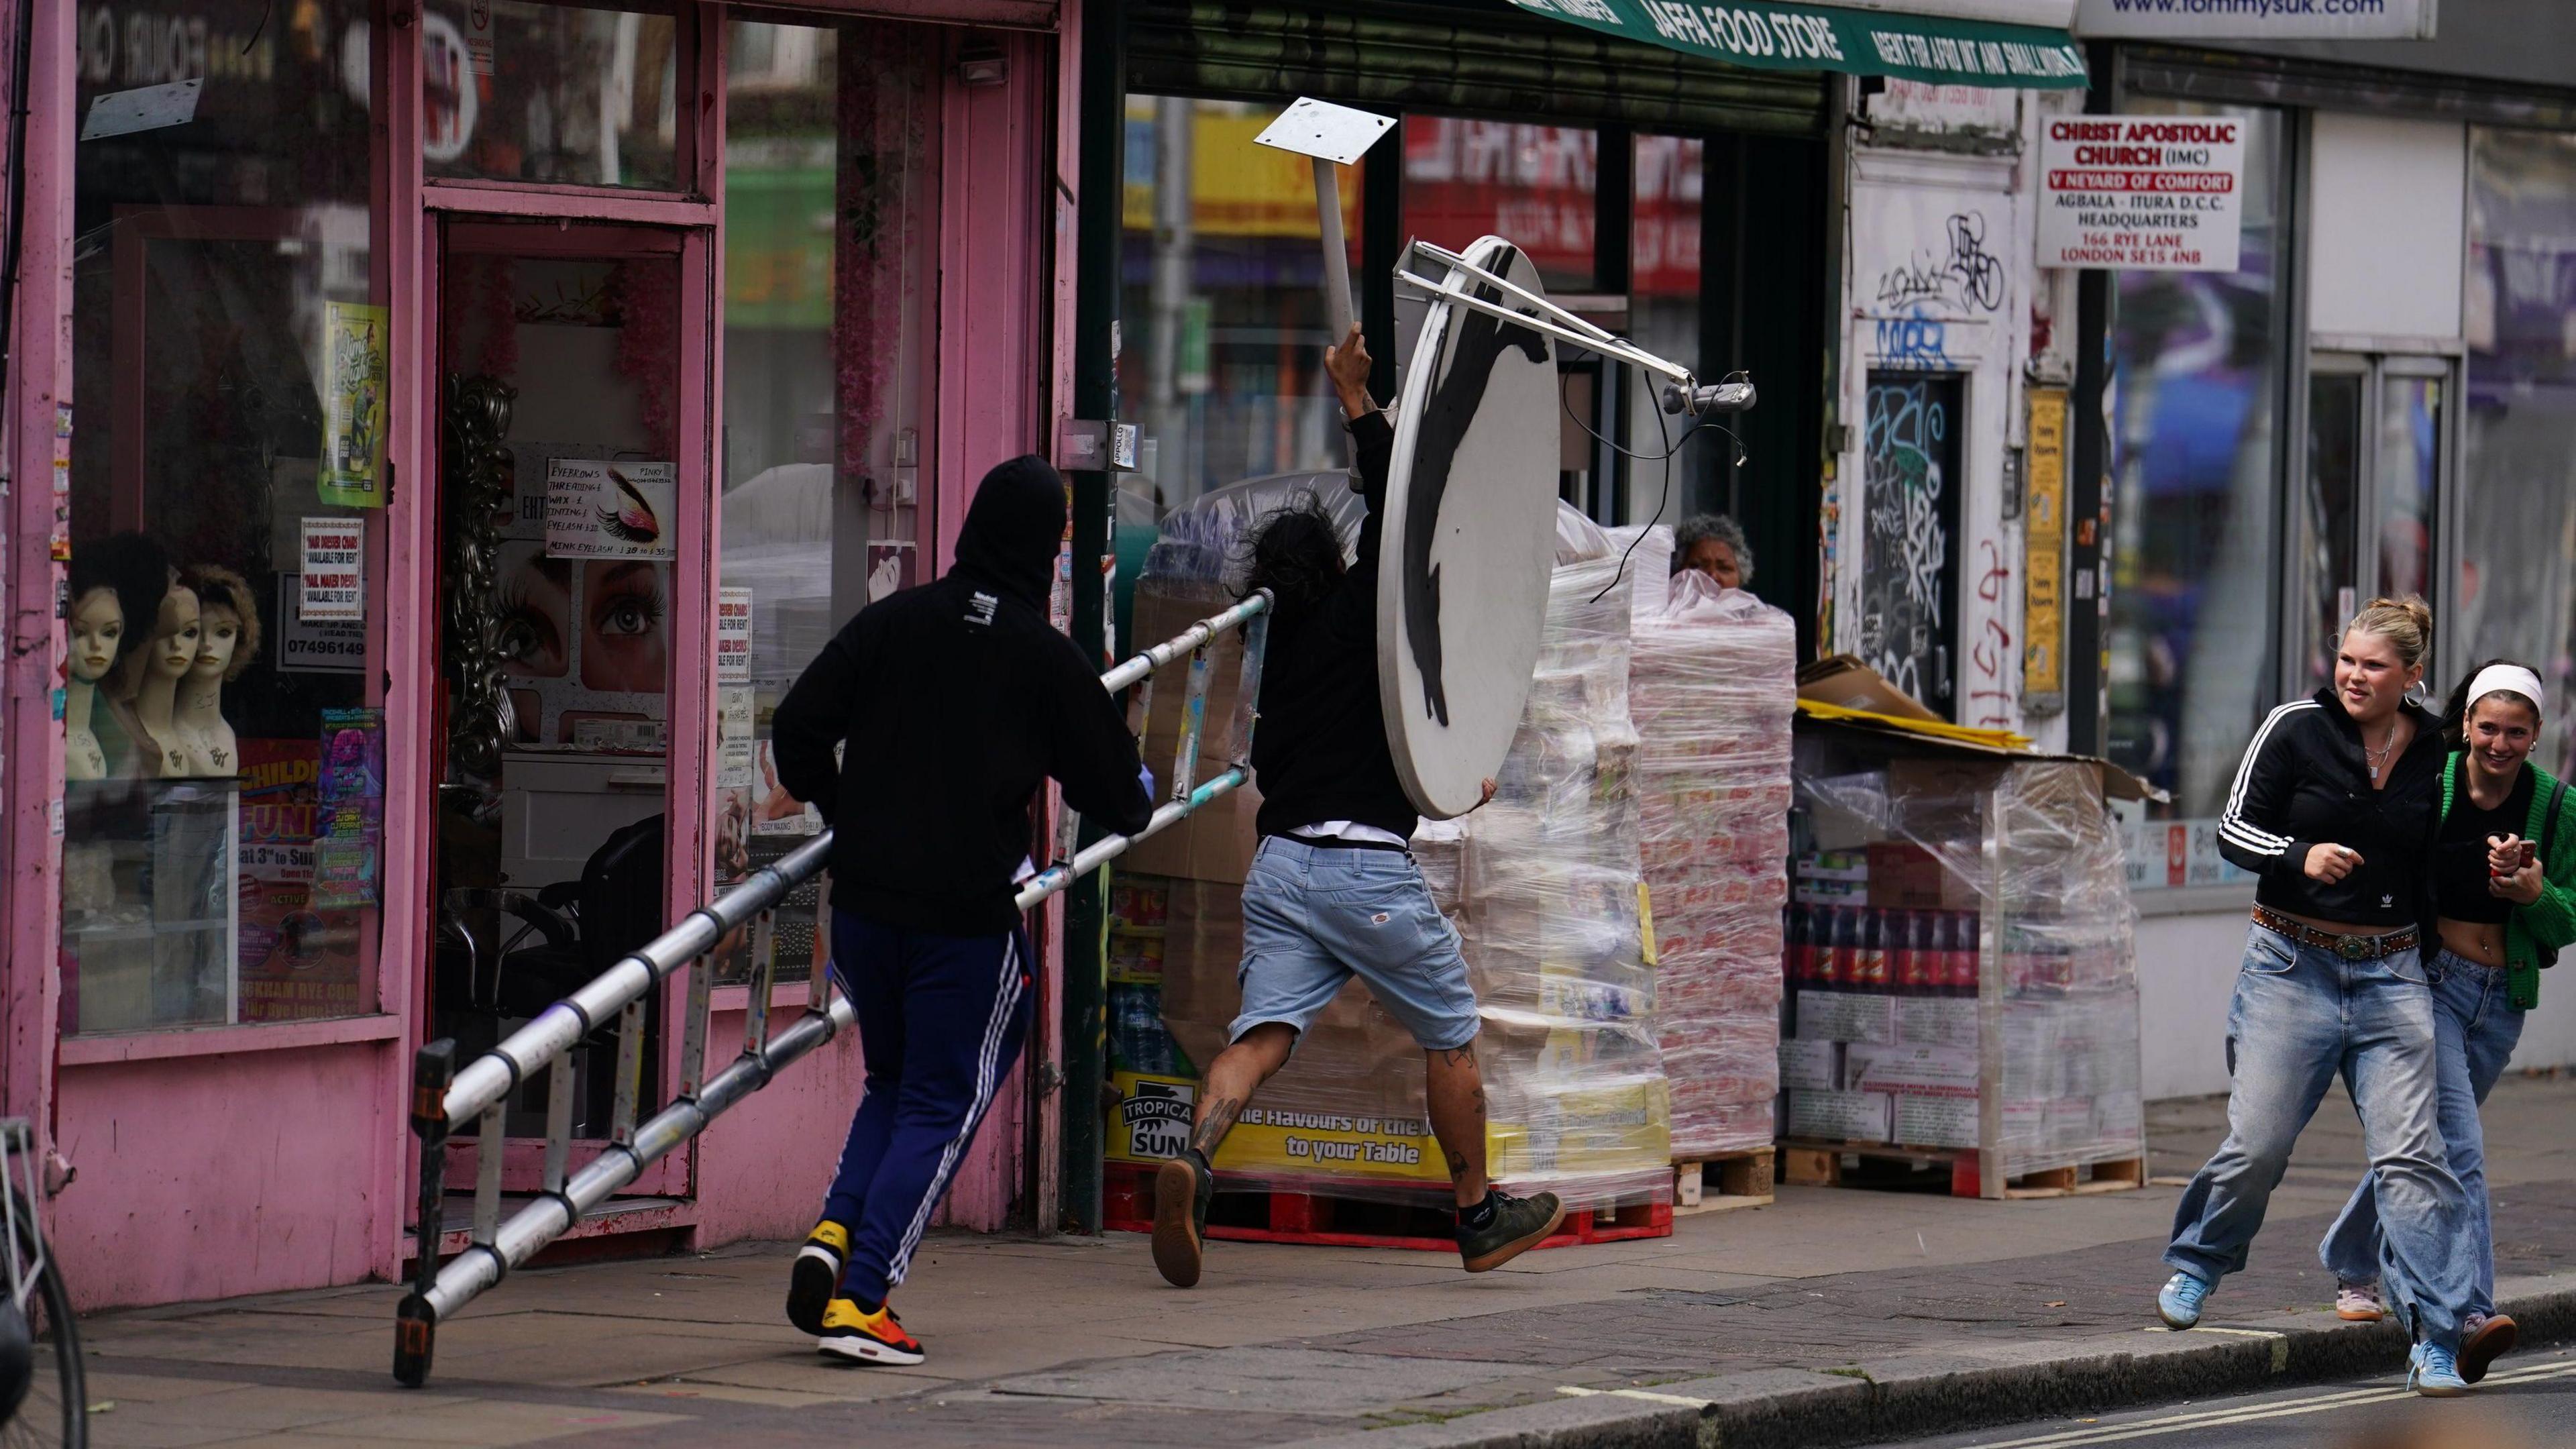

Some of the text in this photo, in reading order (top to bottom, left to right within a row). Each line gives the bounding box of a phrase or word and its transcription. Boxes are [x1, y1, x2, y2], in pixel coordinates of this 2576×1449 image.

[1641, 0, 1845, 61] JAFFA FOOD STORE
[2051, 122, 2235, 143] CHRIST APOSTOLIC
[2075, 146, 2209, 166] CHURCH (IMC)
[2130, 173, 2151, 189] OF
[2155, 173, 2231, 191] COMFORT
[2055, 194, 2114, 208] AGBALA
[2130, 196, 2174, 209] ITURA
[2180, 197, 2224, 210] D.C.C.
[2078, 212, 2198, 229] HEADQUARTERS
[2083, 233, 2182, 247] 166 RYE LANE
[2061, 248, 2201, 264] LONDON SE15 4NB
[1115, 427, 1124, 464] APPOLLO
[551, 467, 662, 478] EYEBROWS PINKY
[523, 496, 546, 519] EXT
[549, 495, 568, 504] WAX
[549, 541, 576, 550] MINK
[578, 543, 613, 553] EYELASH
[335, 553, 345, 564] FOR
[346, 553, 358, 564] RENT
[334, 591, 343, 602] FOR
[345, 592, 357, 603] RENT
[727, 619, 736, 630] FOR
[737, 619, 747, 630] RENT
[288, 640, 364, 655] 07496149
[718, 640, 731, 651] AKER
[727, 655, 735, 666] FOR
[736, 655, 746, 666] RENT
[239, 849, 255, 863] at
[275, 853, 286, 865] to
[280, 869, 301, 878] Open
[270, 894, 306, 904] ACTIVE
[1124, 1099, 1193, 1120] TROPICA
[1239, 1109, 1263, 1124] he
[1382, 1119, 1419, 1136] the
[1134, 1132, 1185, 1155] SUN
[1287, 1136, 1419, 1165] to your Table
